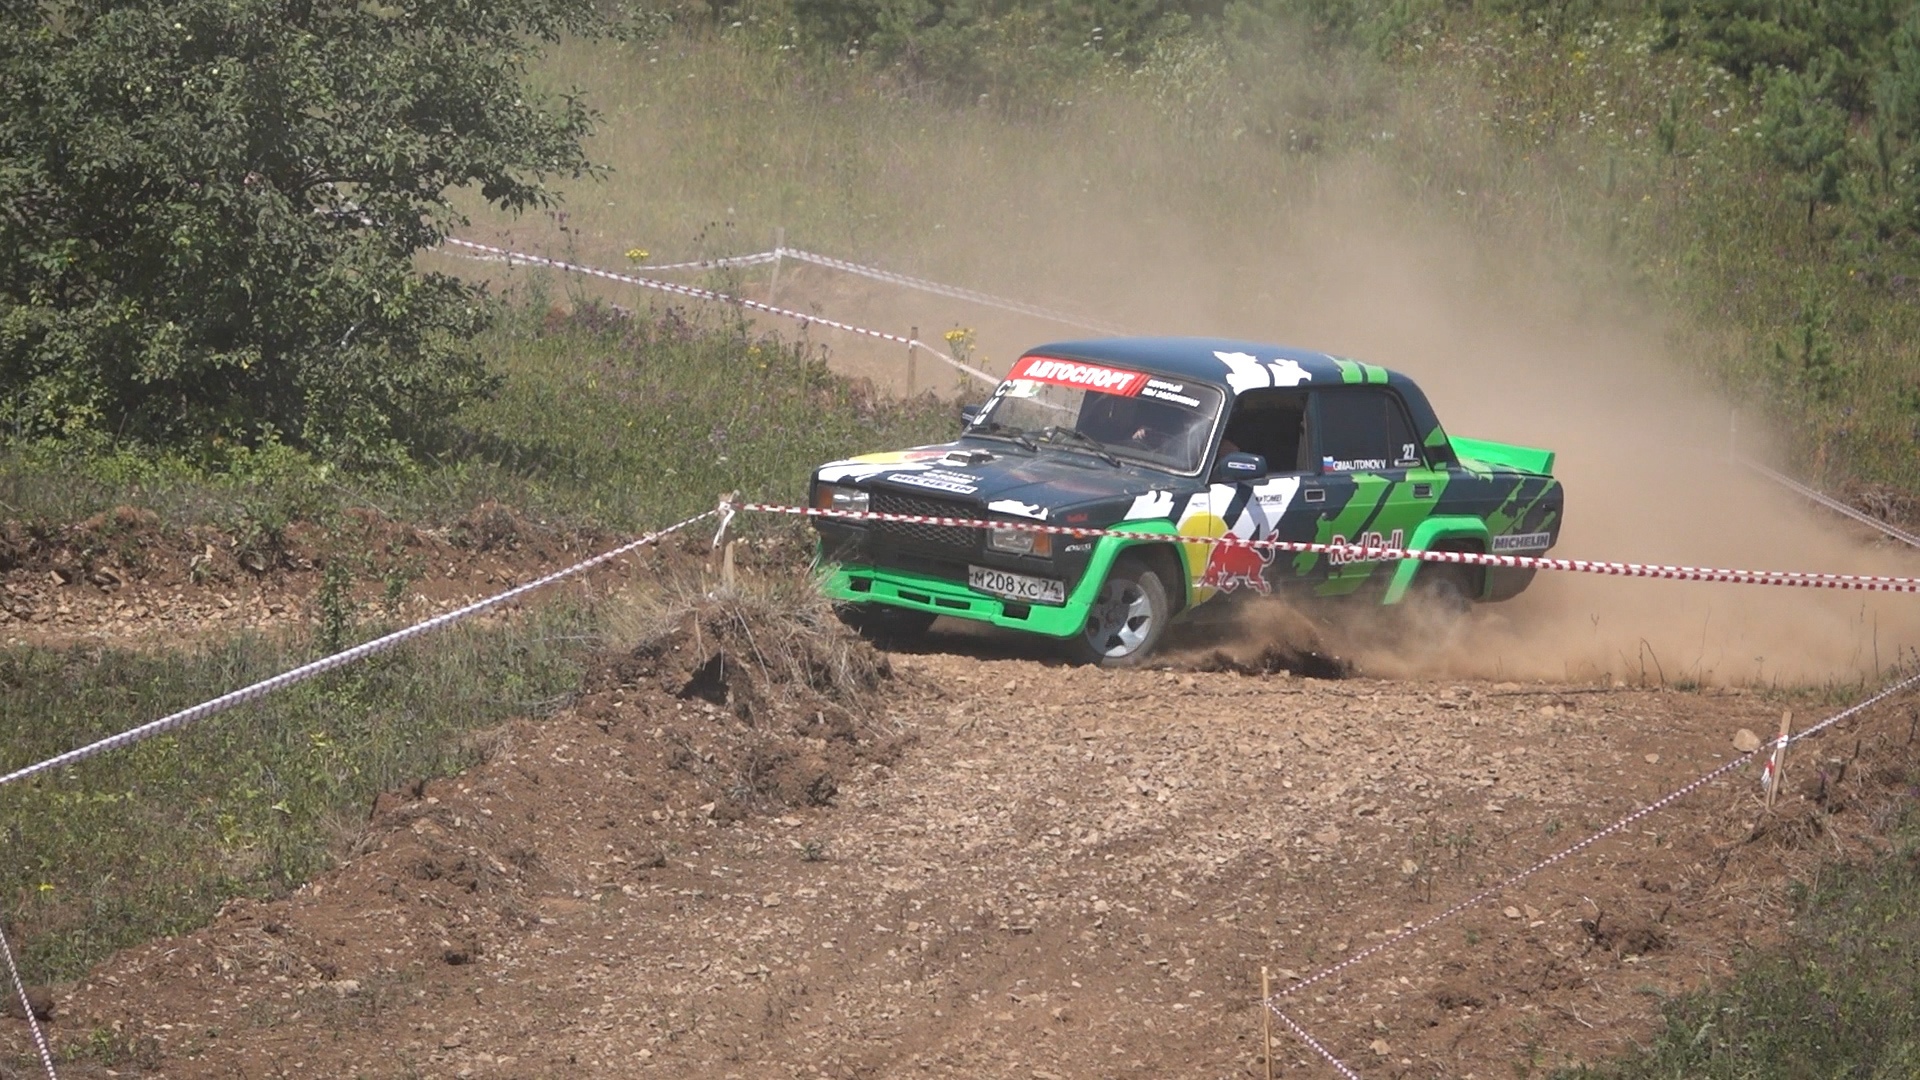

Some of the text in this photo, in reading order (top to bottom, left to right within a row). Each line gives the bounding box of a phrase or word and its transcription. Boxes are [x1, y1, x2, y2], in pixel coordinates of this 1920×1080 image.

[1023, 360, 1135, 390] АВТОСПОРТ
[1402, 443, 1415, 460] 27
[891, 474, 975, 492] MICHELIN
[1330, 532, 1368, 565] Red
[1494, 534, 1549, 550] MICHELIN
